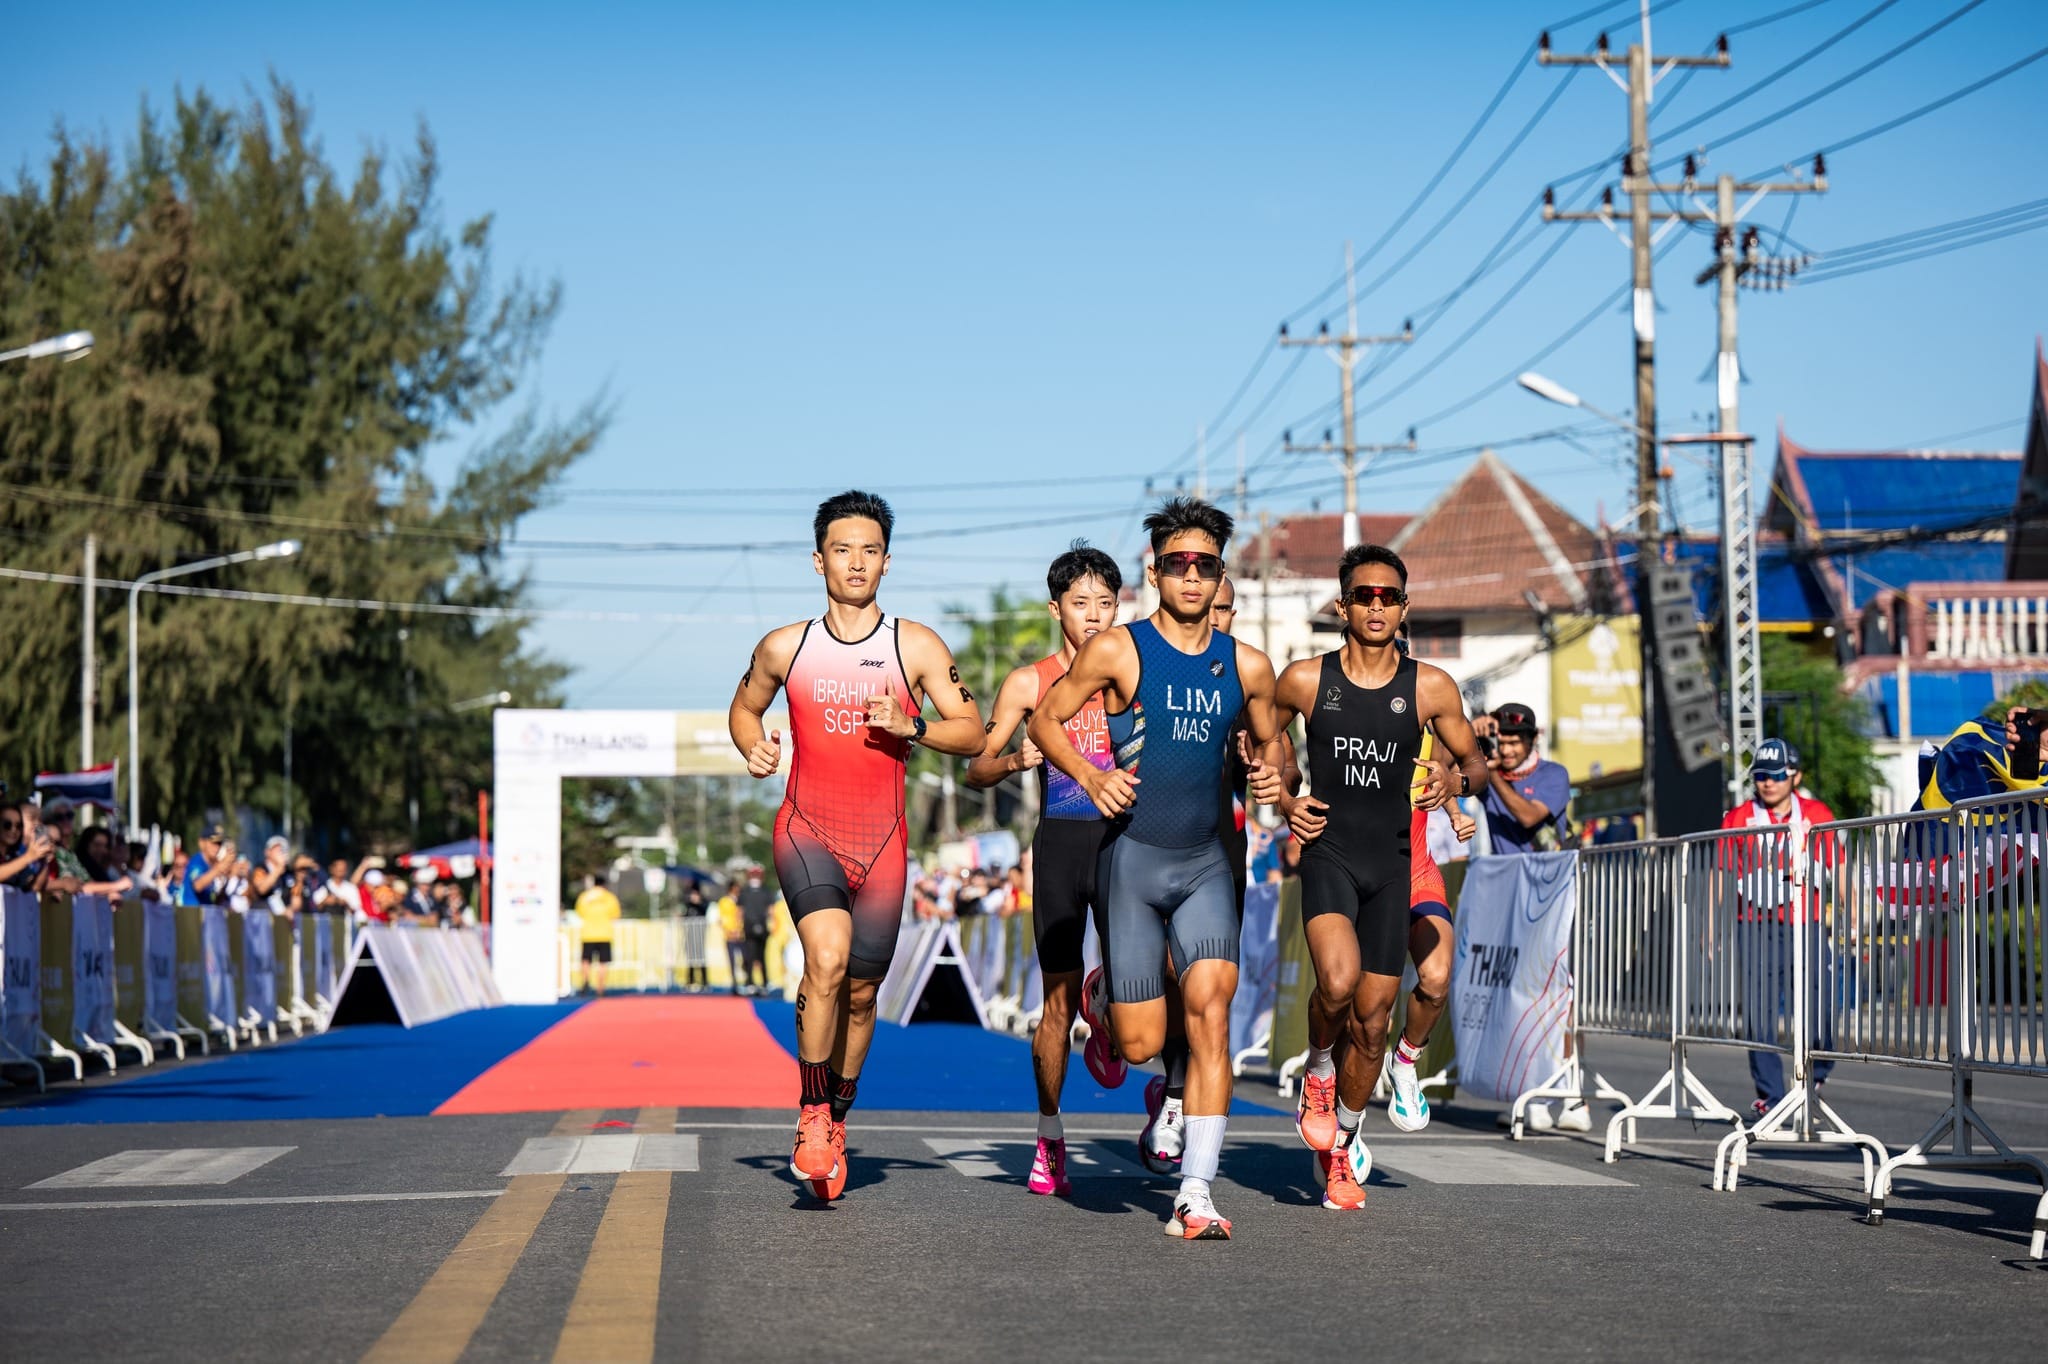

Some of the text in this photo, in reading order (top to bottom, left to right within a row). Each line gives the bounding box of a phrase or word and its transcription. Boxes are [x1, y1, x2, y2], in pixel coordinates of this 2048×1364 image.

[949, 665, 960, 684] 6
[813, 678, 876, 707] IBRAHIM
[959, 686, 974, 703] A
[1167, 684, 1221, 716] LIM
[824, 708, 864, 735] SGP
[1172, 716, 1211, 743] MAS
[1076, 731, 1105, 754] VIE
[1334, 736, 1398, 763] PRAJI
[1345, 764, 1381, 789] INA
[798, 992, 807, 1011] 6
